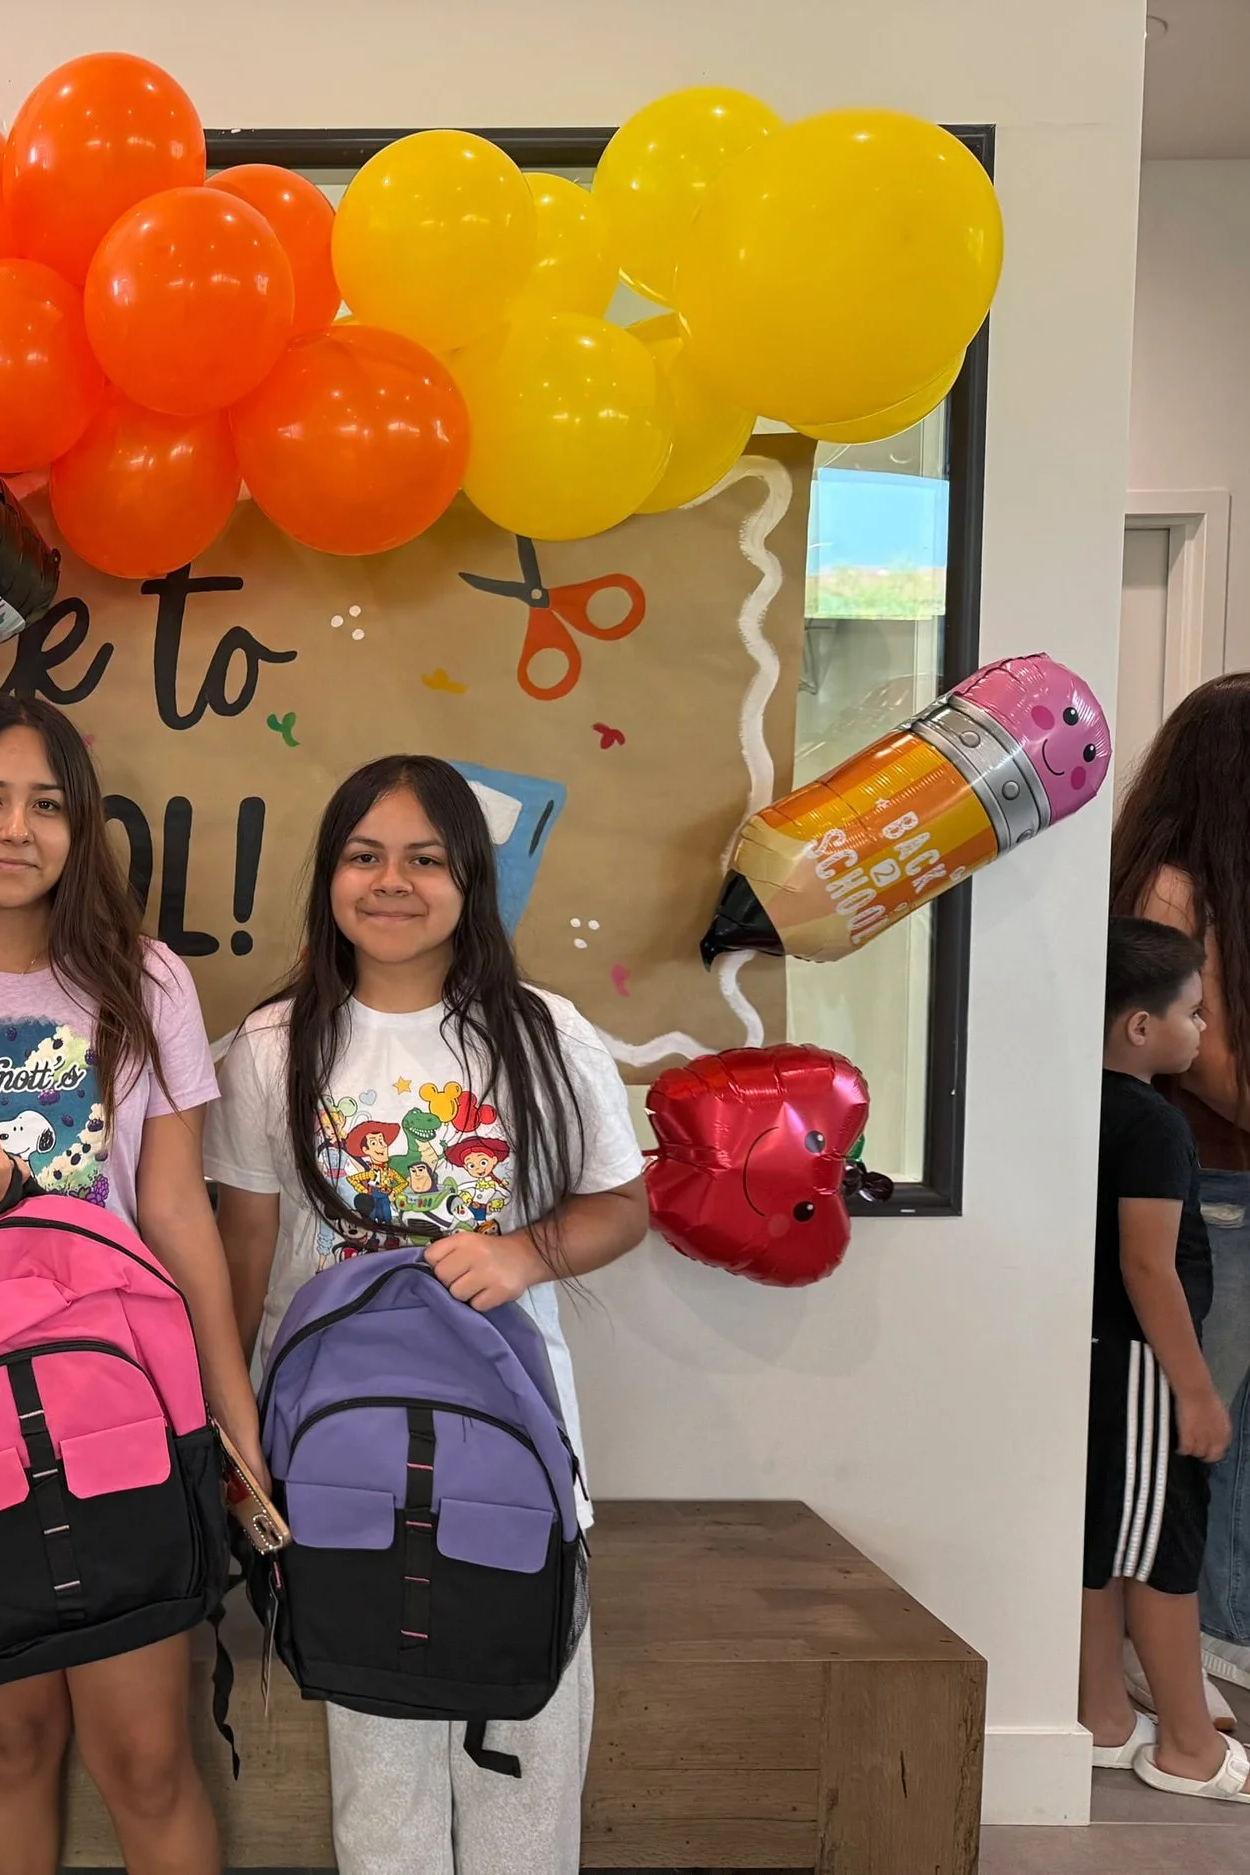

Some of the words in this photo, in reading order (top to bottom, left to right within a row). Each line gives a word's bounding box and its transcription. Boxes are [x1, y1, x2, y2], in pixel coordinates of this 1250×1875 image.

[141, 563, 298, 731] to
[803, 828, 890, 945] SCHOOL
[872, 861, 898, 885] 2
[881, 810, 947, 894] BACK
